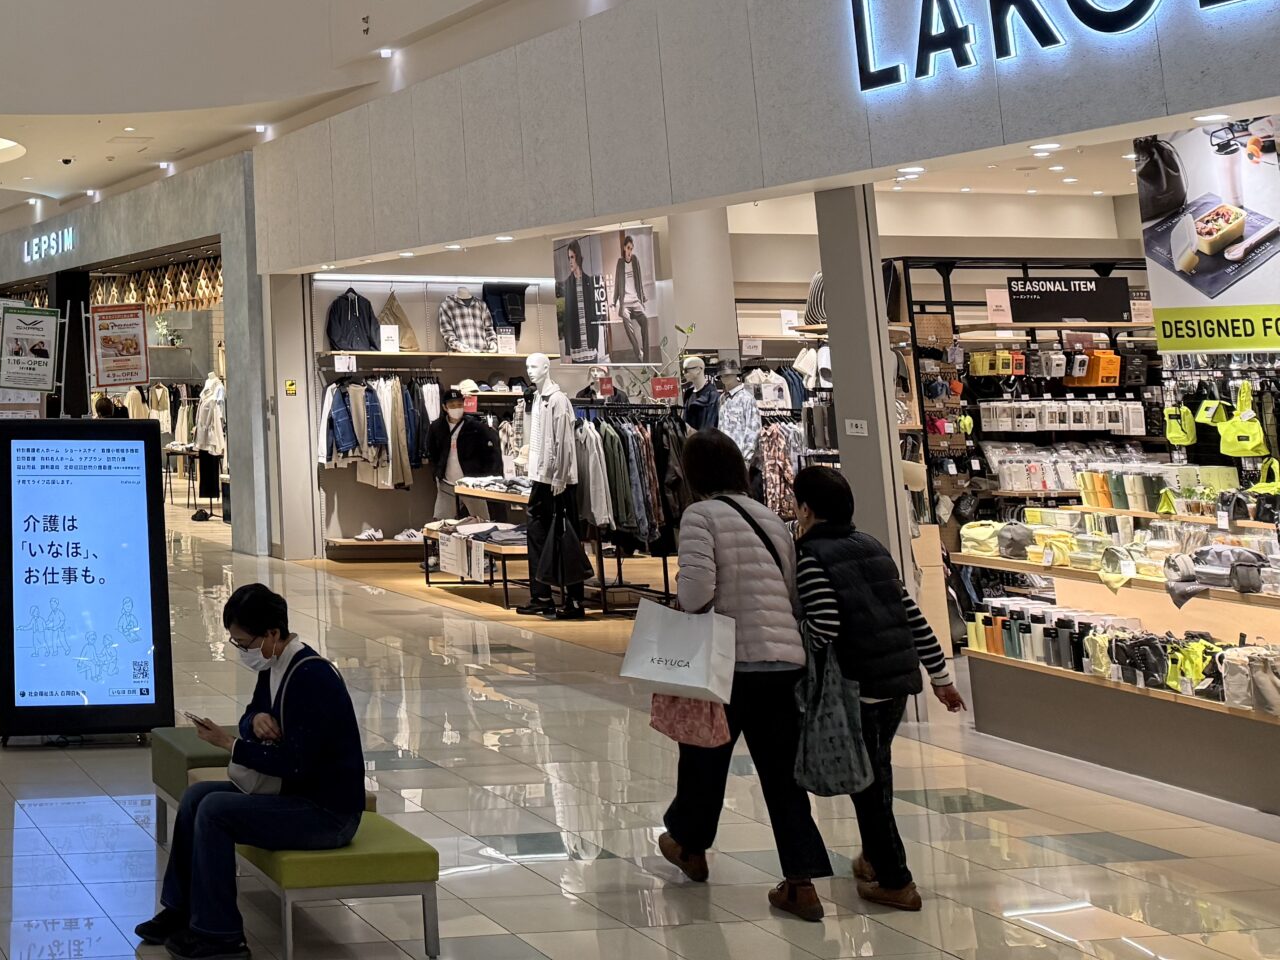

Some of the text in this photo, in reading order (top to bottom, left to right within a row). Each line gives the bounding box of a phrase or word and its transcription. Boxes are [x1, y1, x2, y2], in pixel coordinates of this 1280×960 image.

[1011, 280, 1096, 292] SEASONAL ITEM
[1161, 318, 1255, 339] DESIGNED
[26, 359, 49, 367] OPEN
[24, 514, 78, 533] 介護は
[21, 541, 98, 559] 「いなほ」、
[24, 566, 106, 585] お仕事も。
[650, 656, 691, 669] KEYUCA
